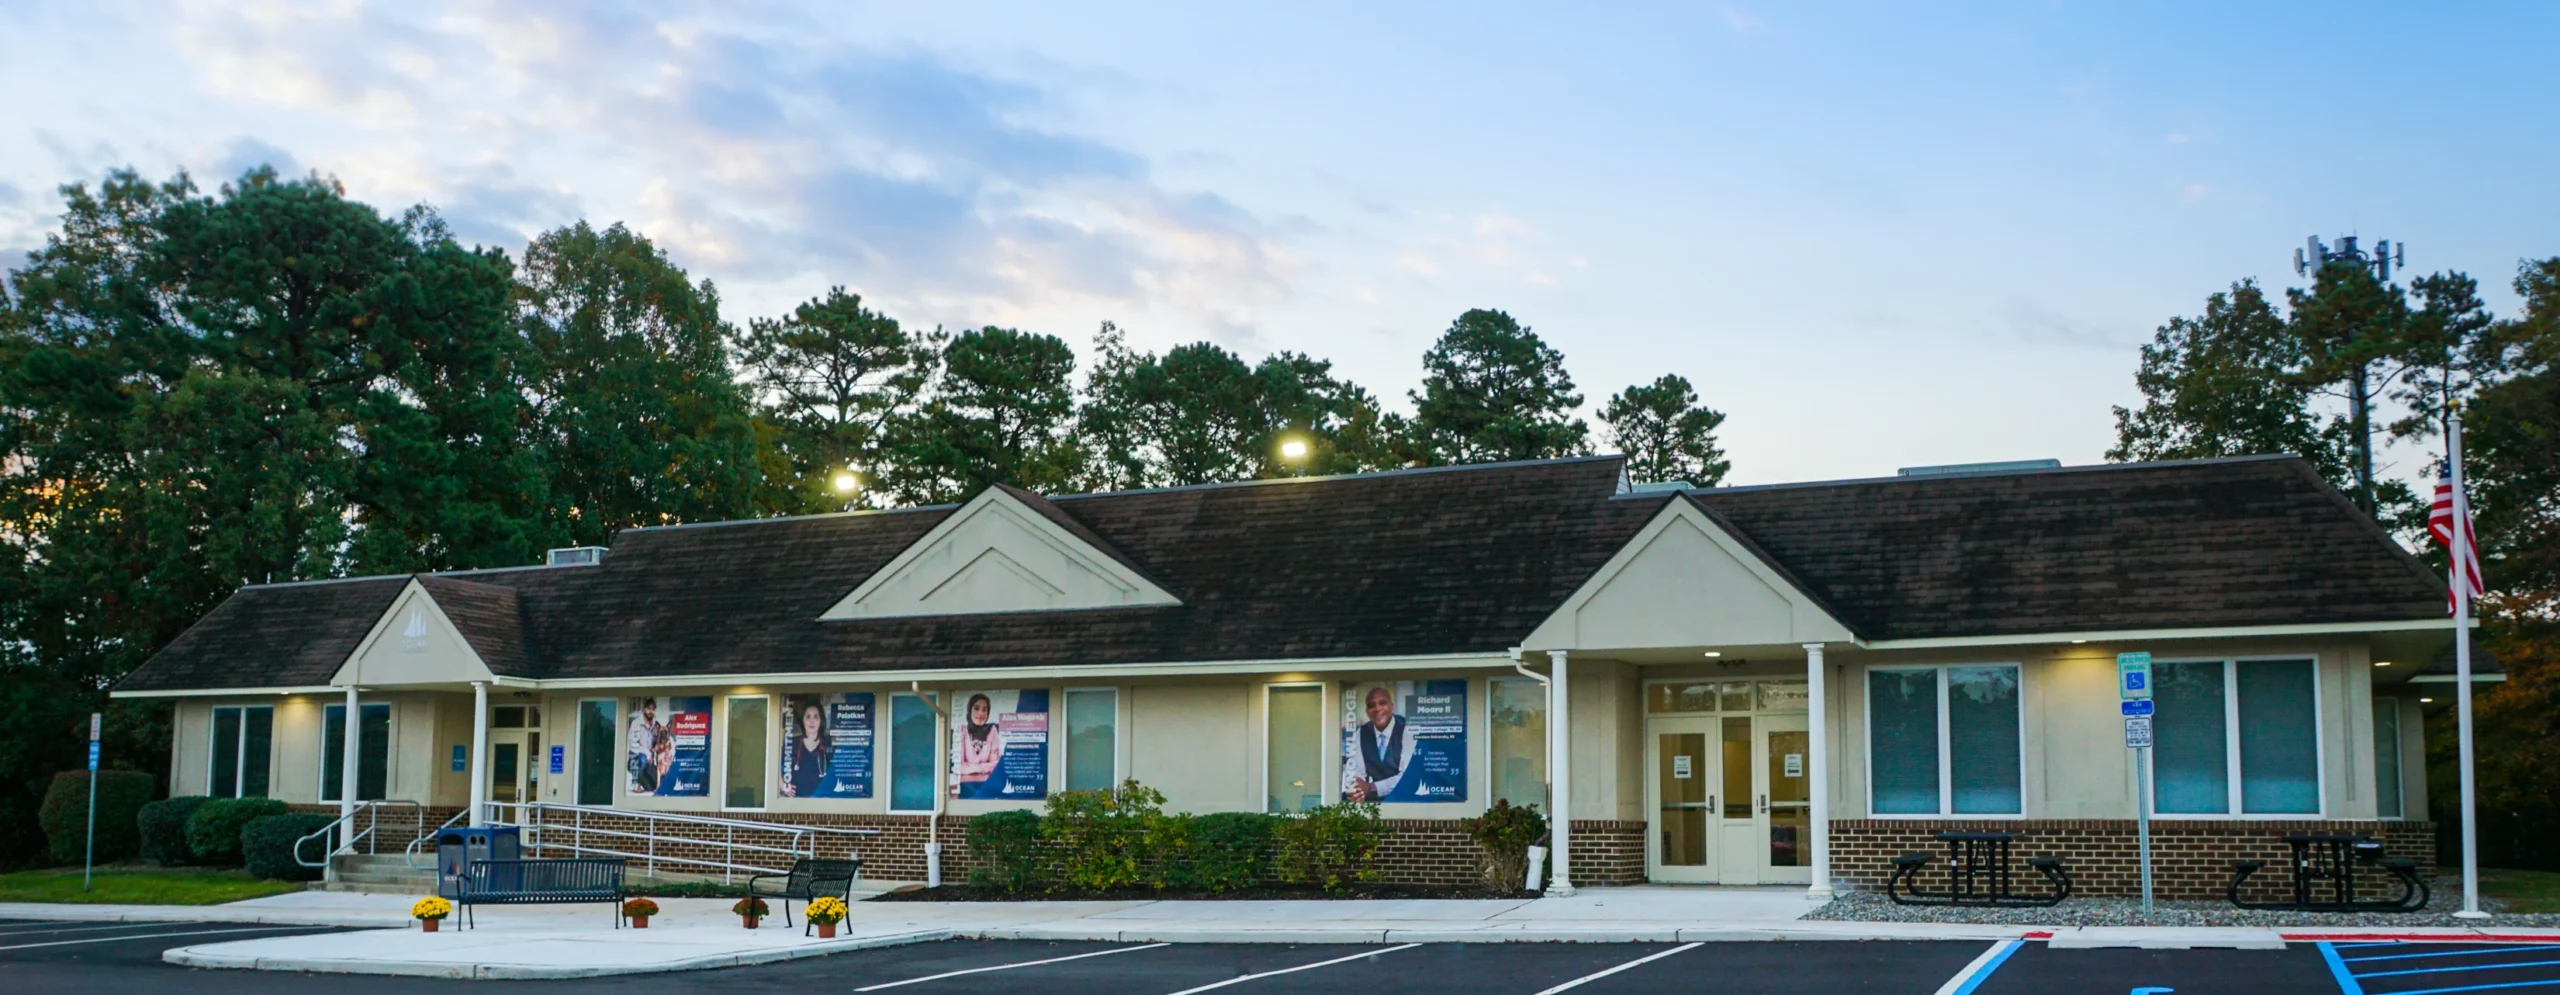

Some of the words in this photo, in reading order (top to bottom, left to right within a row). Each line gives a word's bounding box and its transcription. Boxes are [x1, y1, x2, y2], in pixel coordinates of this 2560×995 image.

[1417, 706, 1444, 714] Moore
[1418, 696, 1451, 704] Richard
[783, 697, 794, 792] COMMITMENT
[1345, 690, 1357, 793] KNOWLEDGE
